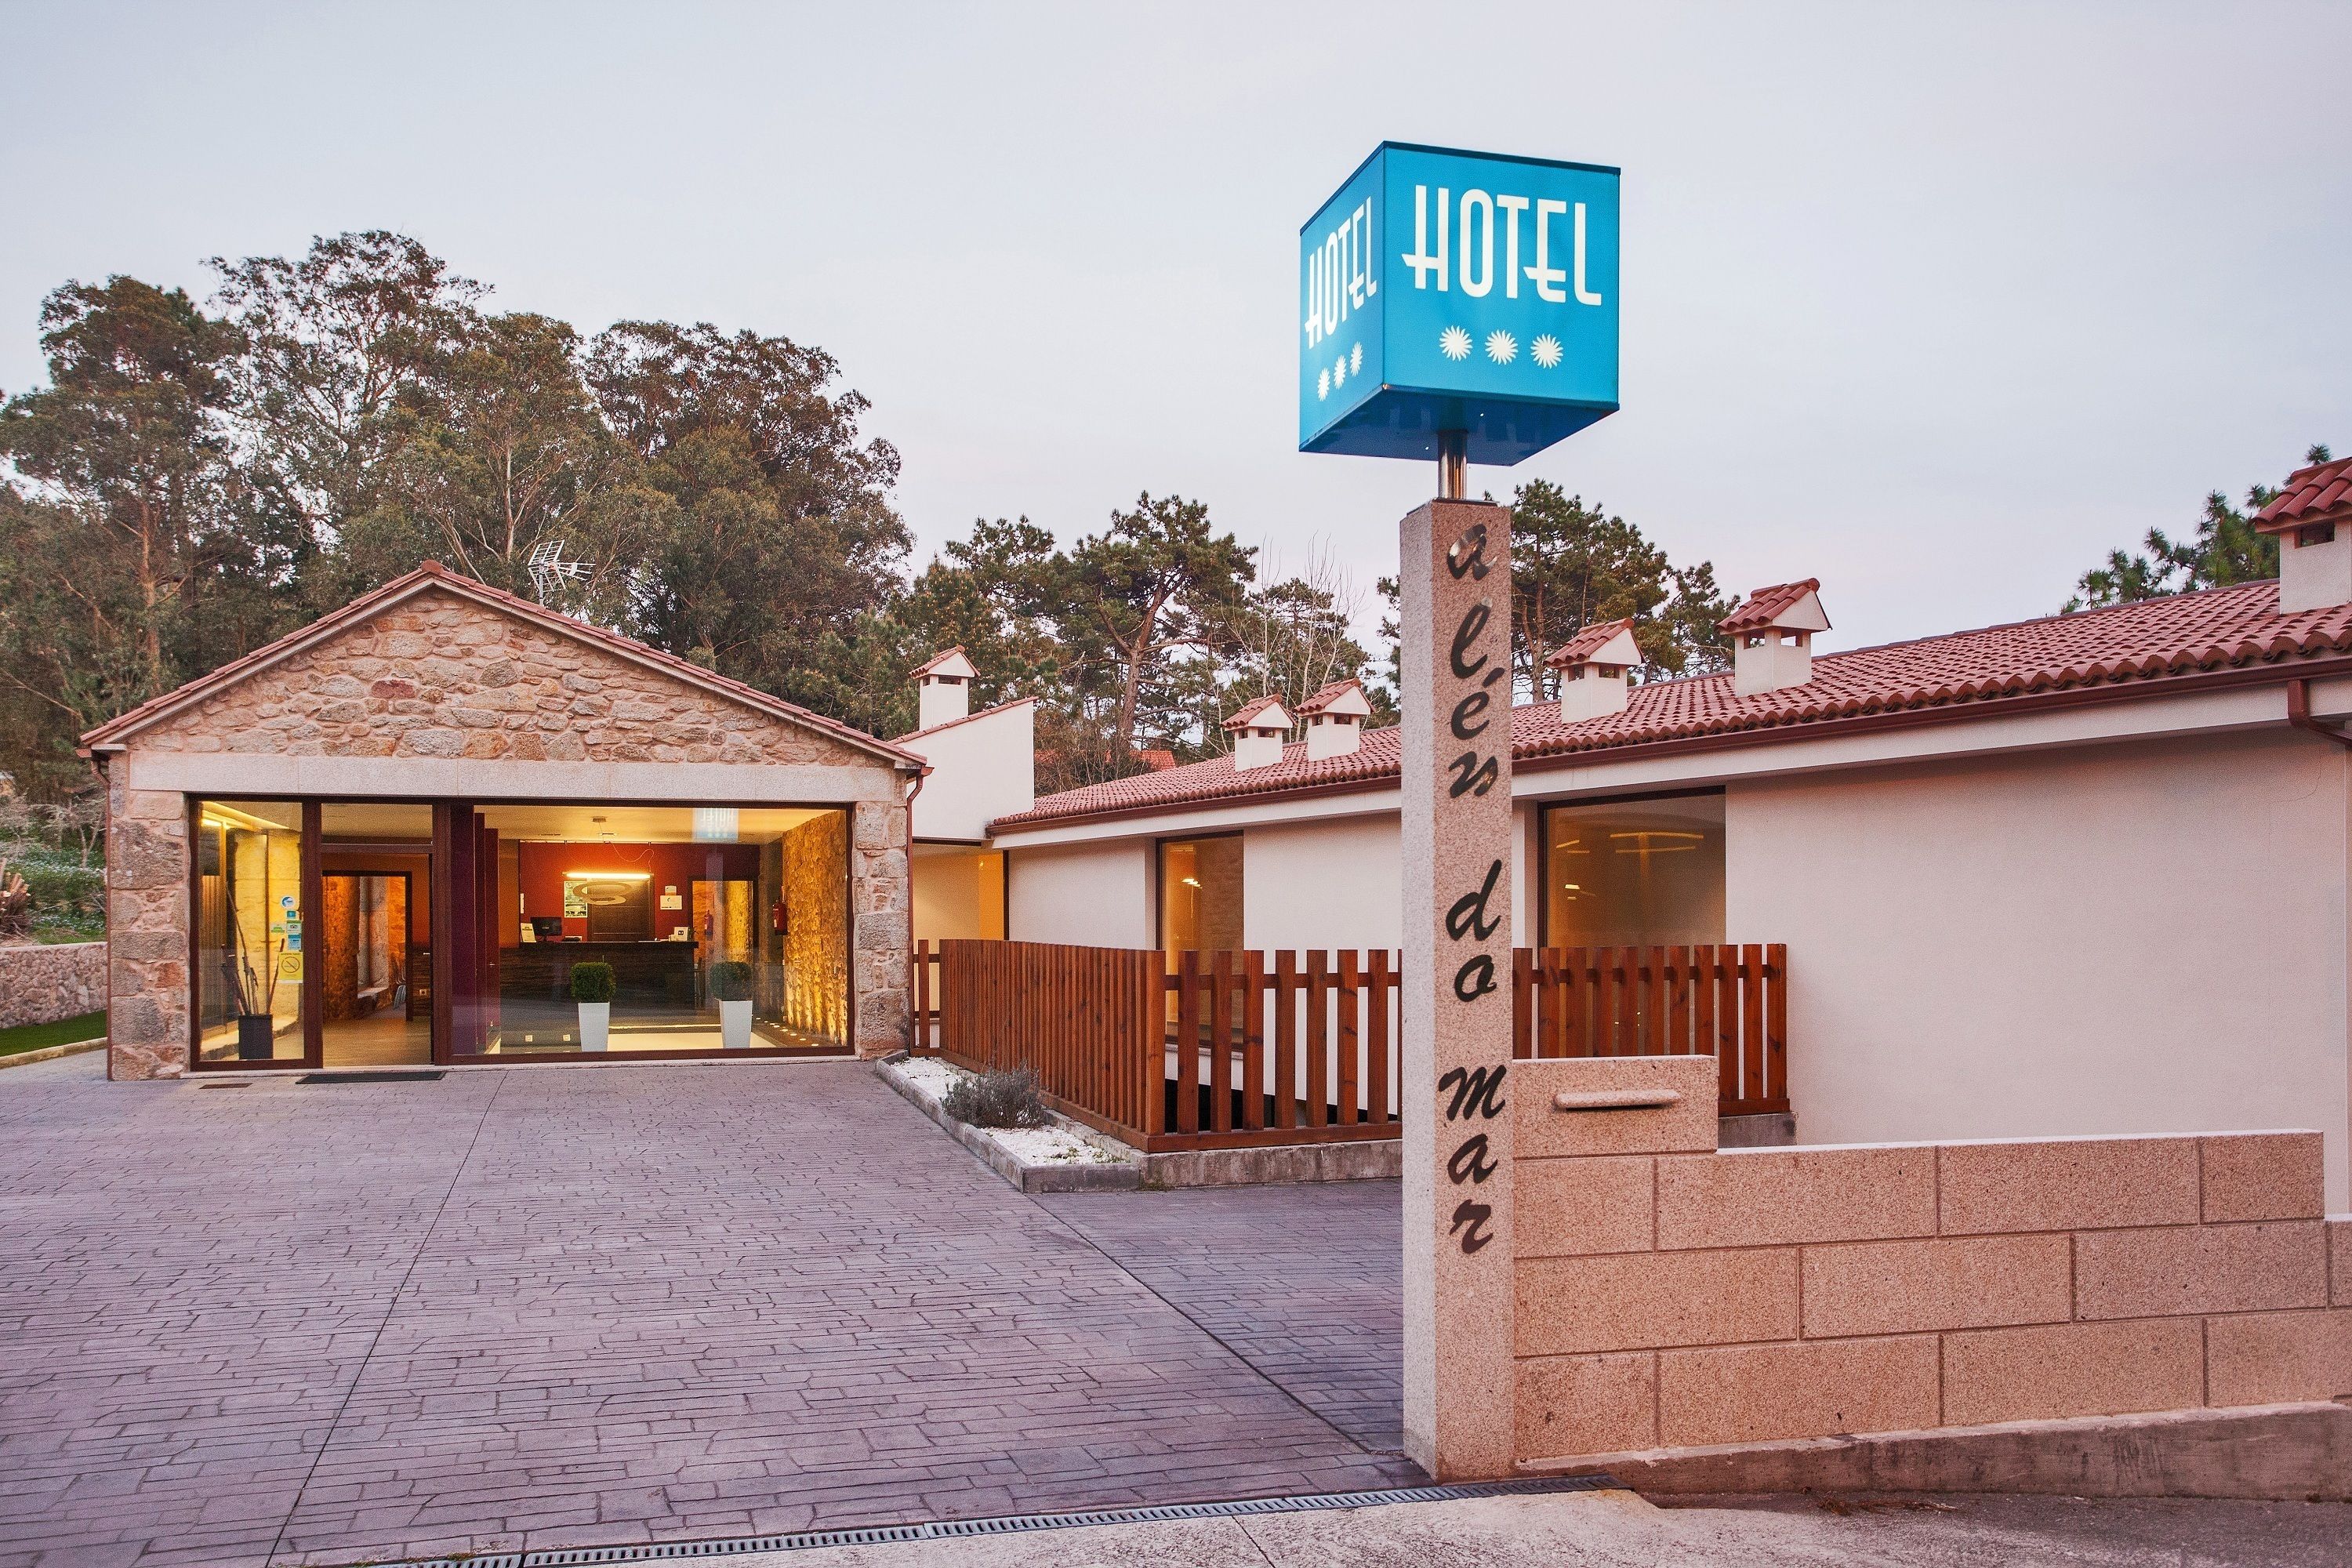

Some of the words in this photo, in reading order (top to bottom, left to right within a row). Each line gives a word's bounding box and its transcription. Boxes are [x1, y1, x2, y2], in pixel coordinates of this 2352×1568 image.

[1305, 196, 1377, 350] HOTEL
[1402, 184, 1602, 306] HOTEL
[1446, 523, 1505, 799] alén
[1445, 859, 1503, 1003] do
[1438, 1065, 1507, 1254] mar
